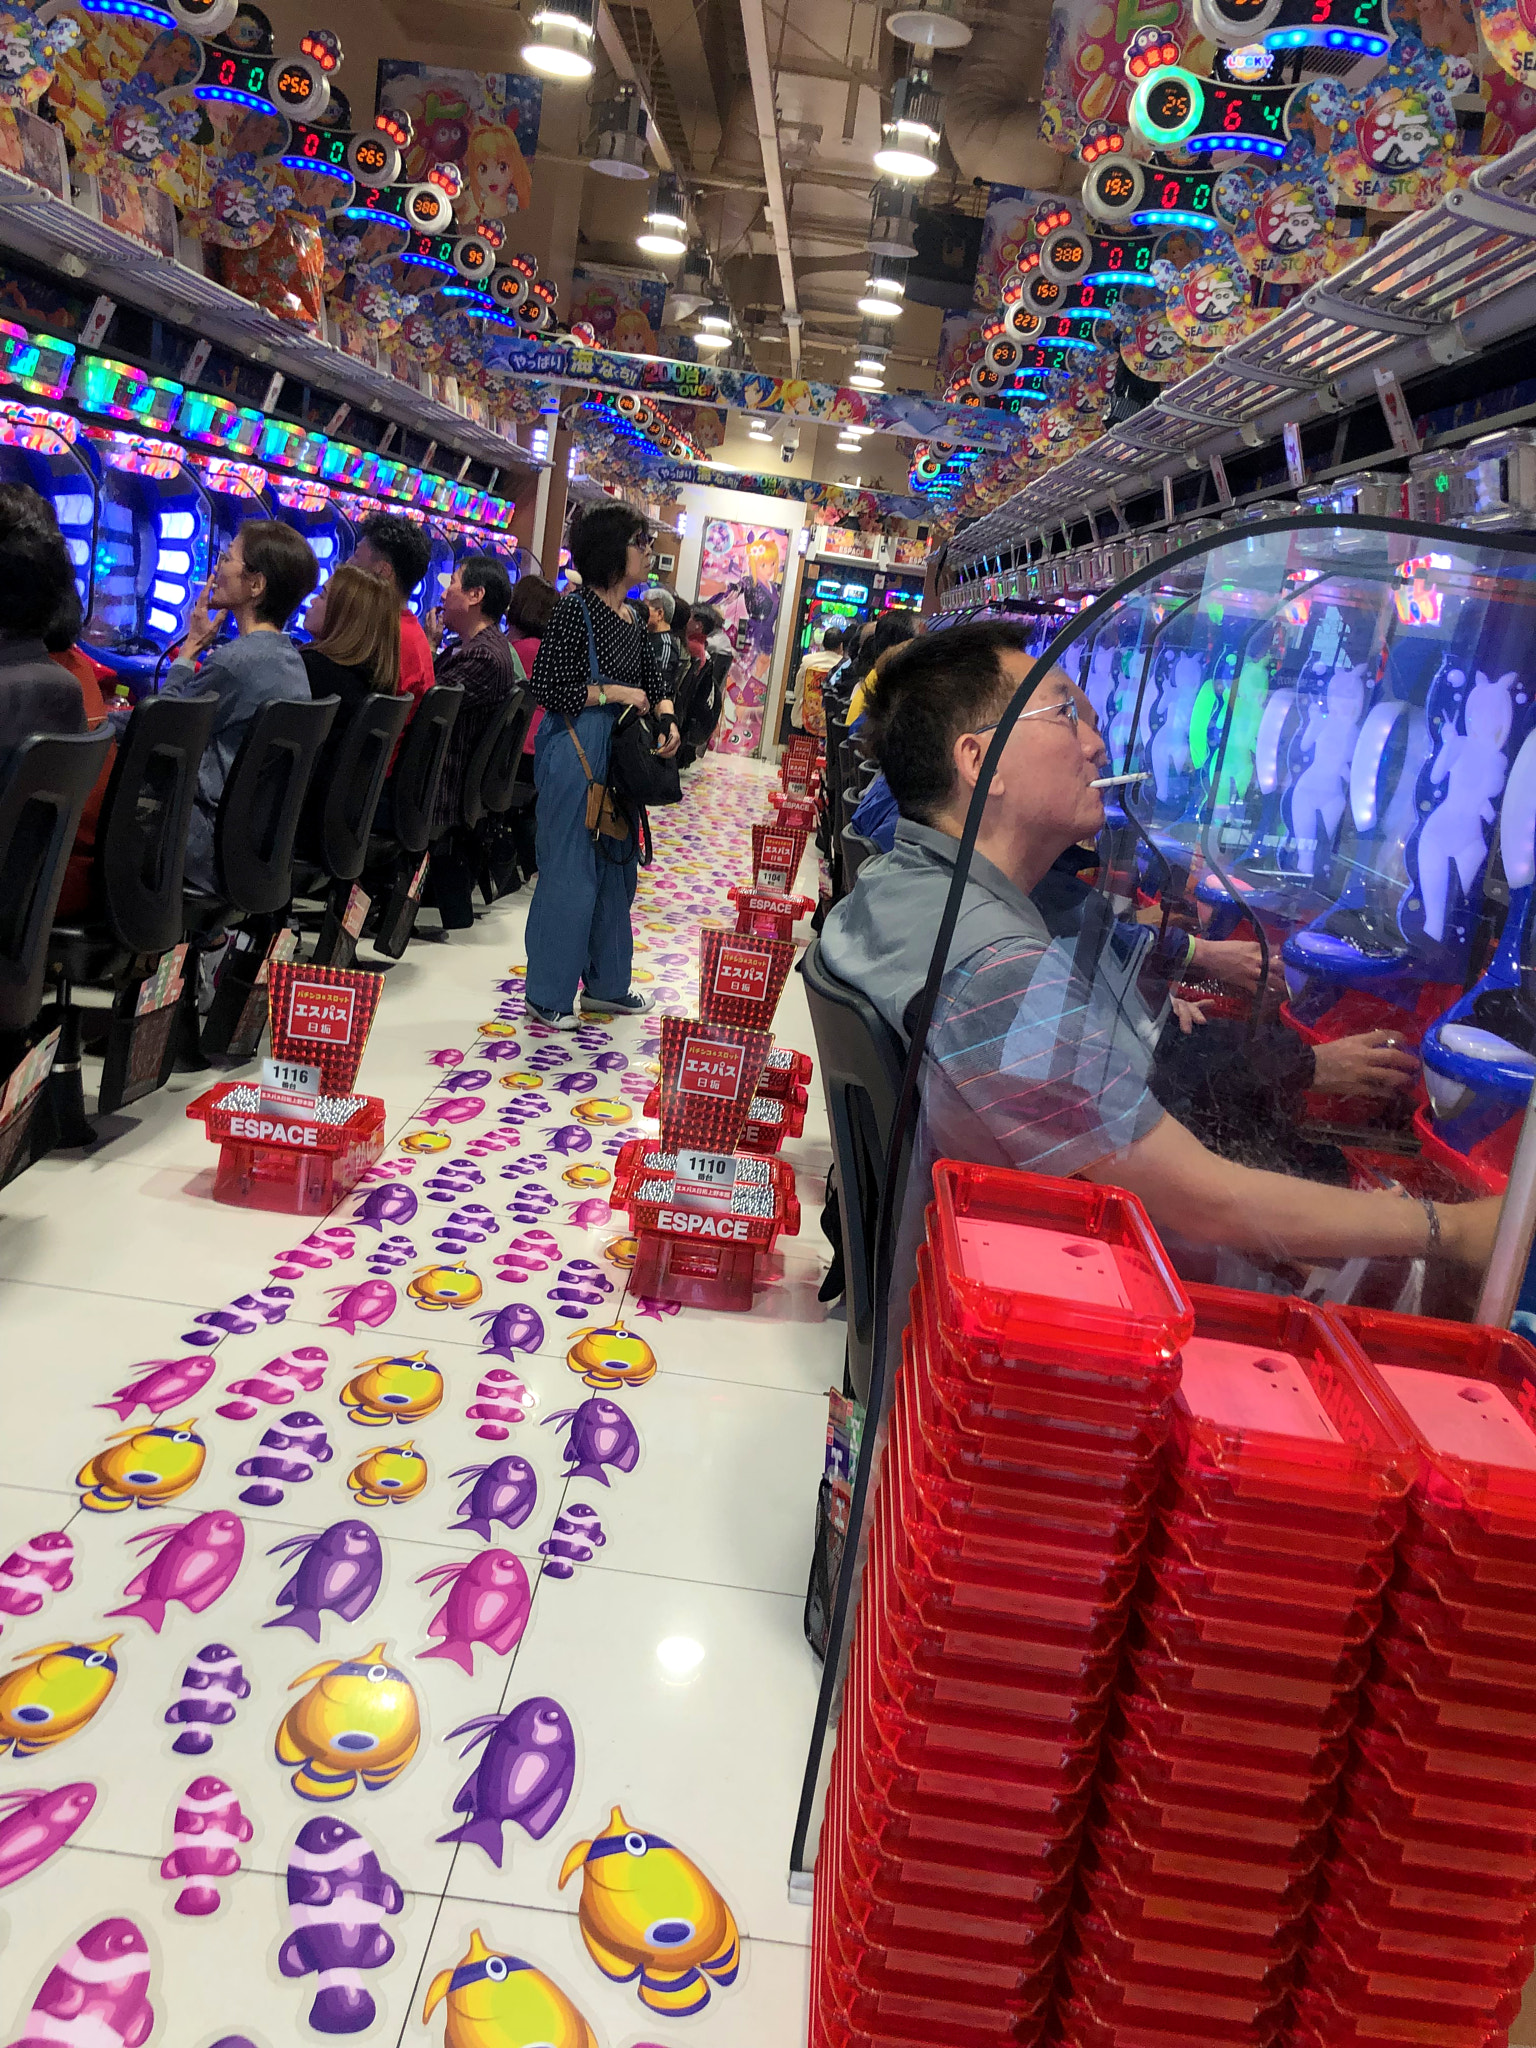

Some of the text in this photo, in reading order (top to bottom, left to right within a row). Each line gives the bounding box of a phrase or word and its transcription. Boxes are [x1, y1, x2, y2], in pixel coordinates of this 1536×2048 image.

[1226, 54, 1275, 69] LUCKY
[1511, 48, 1536, 72] SE
[218, 59, 310, 96] 0 0 256
[1162, 95, 1281, 131] 25 6 4
[304, 133, 385, 167] 0 0 265
[1105, 178, 1211, 210] 192 0 0
[1353, 178, 1382, 198] SEA
[366, 188, 380, 208] 2
[413, 200, 439, 215] 388
[419, 237, 432, 255] 0
[439, 242, 452, 261] 0
[1054, 247, 1150, 270] 388 0 0
[1253, 259, 1275, 272] SEA
[1037, 284, 1118, 307] 158 0 0
[1014, 313, 1091, 338] 223 0 0
[1184, 326, 1203, 338] SEA
[513, 352, 562, 370] やっぱり
[994, 348, 1016, 360] 291
[644, 361, 700, 385] 200台
[1133, 362, 1149, 372] SEA
[679, 384, 714, 397] over
[749, 898, 793, 915] ESPACE
[720, 965, 764, 982] エスパス
[294, 1003, 348, 1022] エスパス
[273, 1065, 309, 1084] 1116
[685, 1058, 736, 1078] エスパス
[230, 1116, 319, 1147] ESPACE
[689, 1157, 726, 1175] 1110
[657, 1210, 749, 1241] ESPACE
